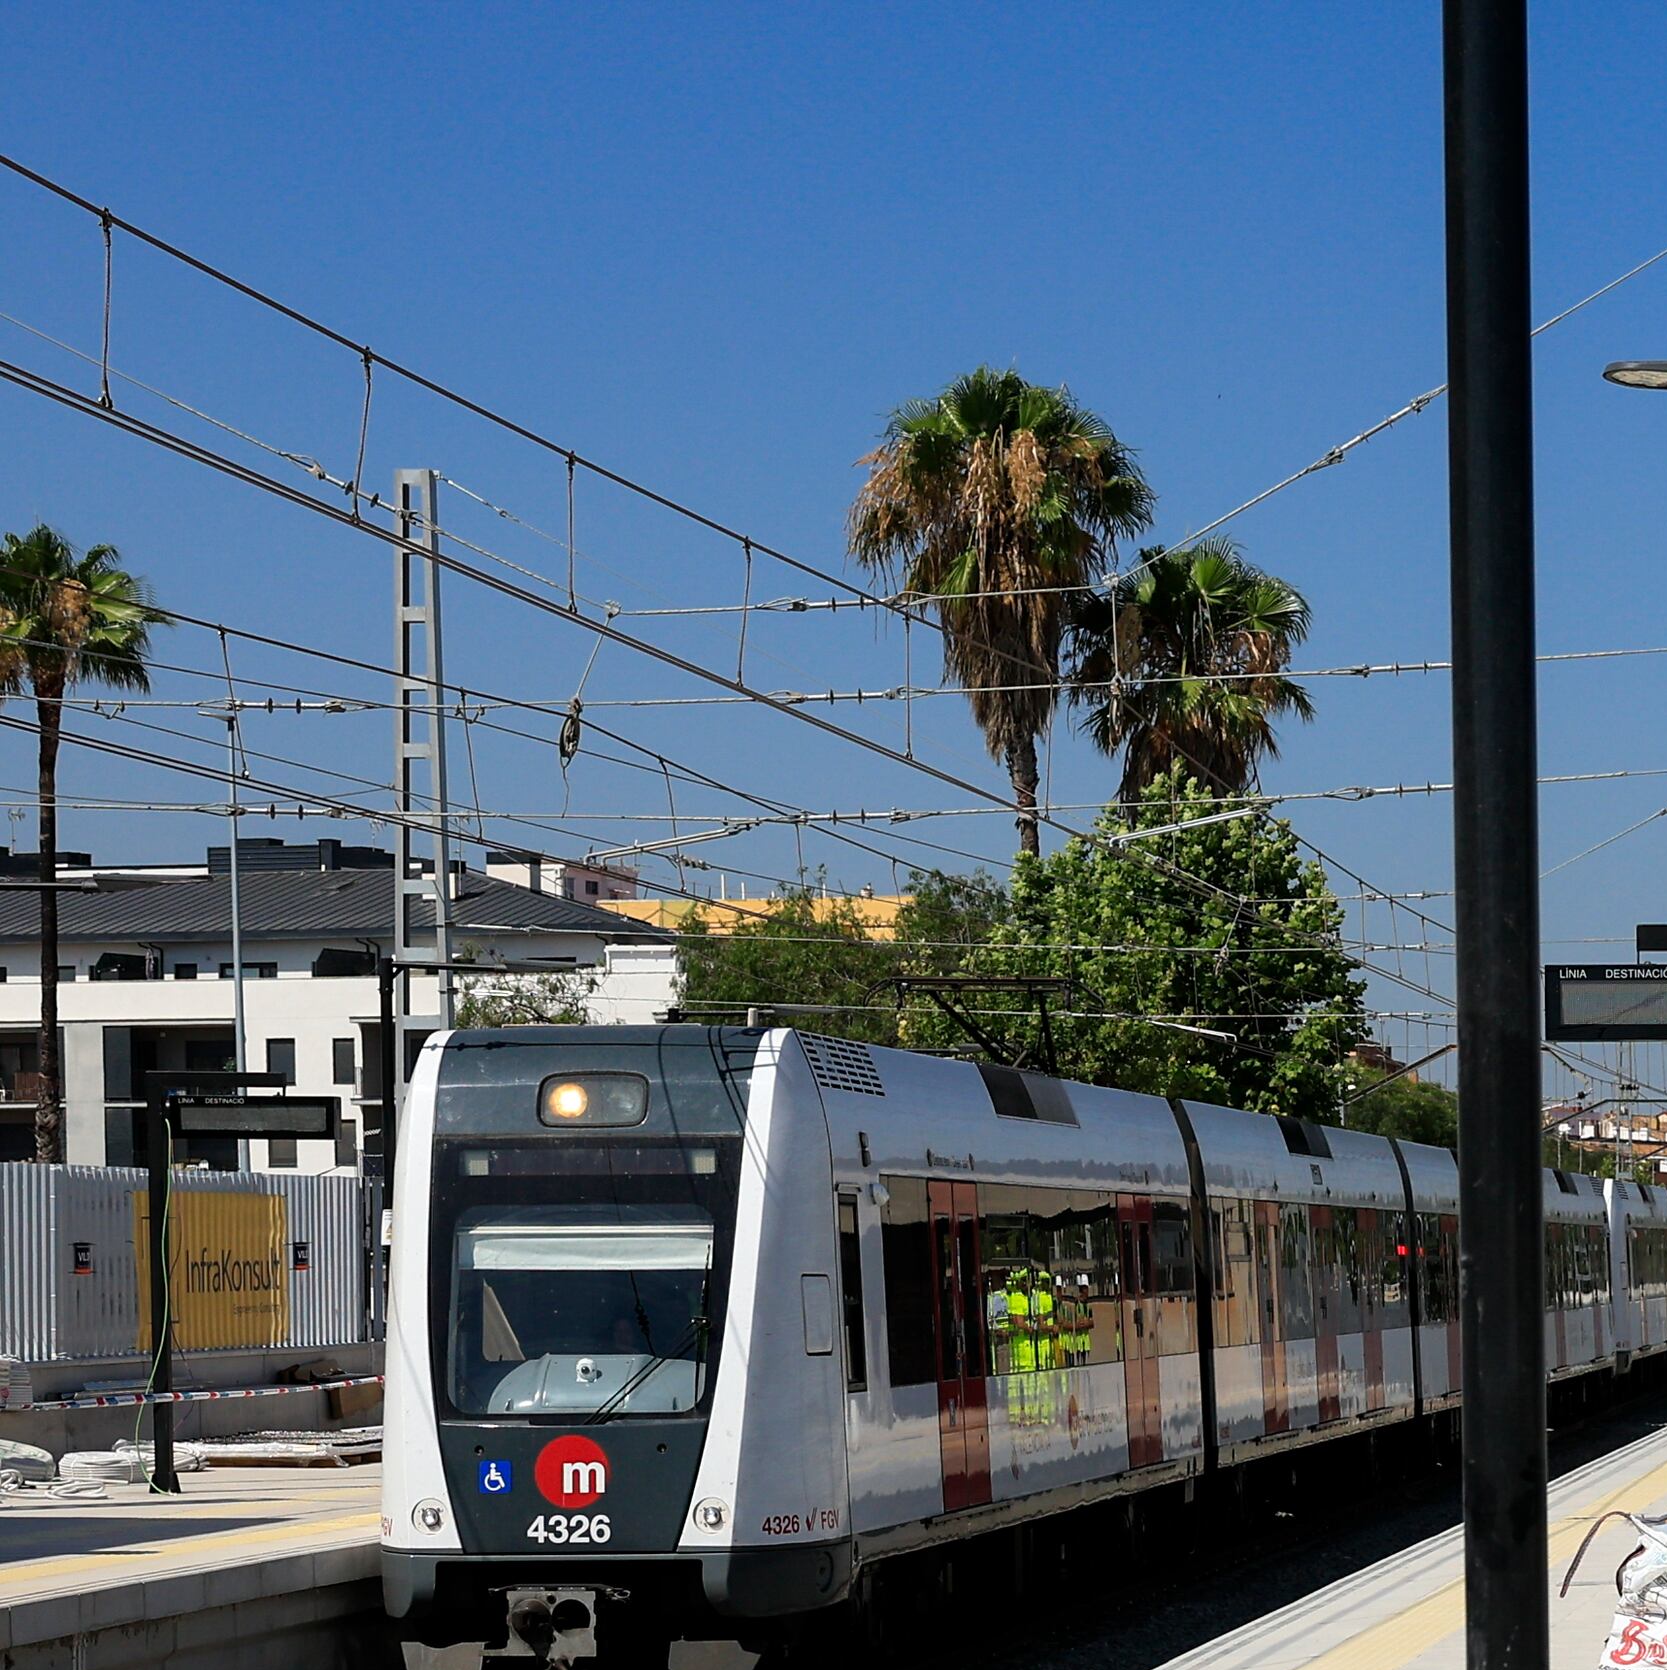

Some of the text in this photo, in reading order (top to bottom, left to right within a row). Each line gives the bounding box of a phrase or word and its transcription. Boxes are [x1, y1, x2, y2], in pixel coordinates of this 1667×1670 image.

[1559, 967, 1587, 979] LÍNIA
[186, 1248, 280, 1293] InfraKonsult
[562, 1461, 606, 1494] m
[527, 1515, 611, 1544] 4326
[762, 1509, 840, 1535] 4326 FGV
